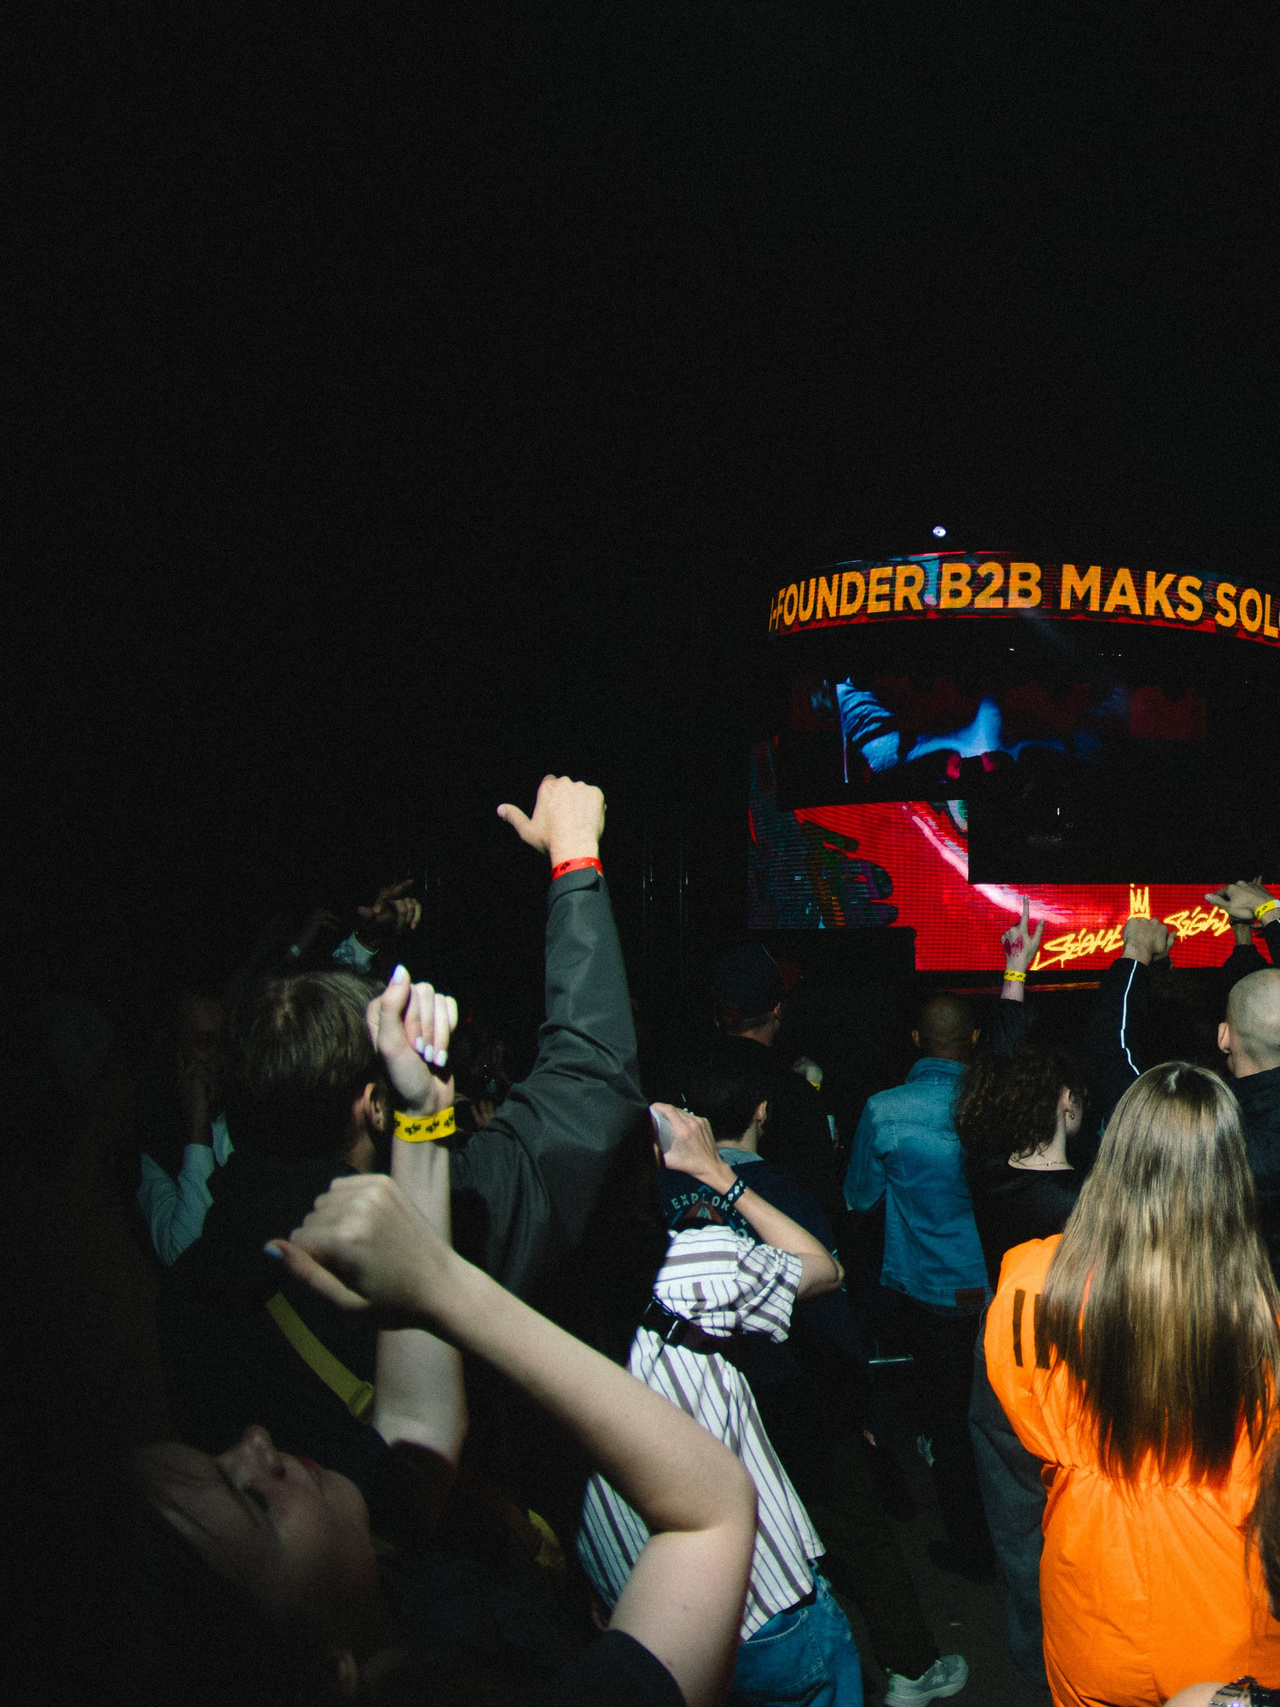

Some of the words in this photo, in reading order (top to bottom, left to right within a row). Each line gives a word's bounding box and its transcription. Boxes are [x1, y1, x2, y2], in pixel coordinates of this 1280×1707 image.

[769, 565, 925, 632] -FOUNDER
[940, 562, 1042, 609] B2B
[1060, 564, 1204, 622] MAKS
